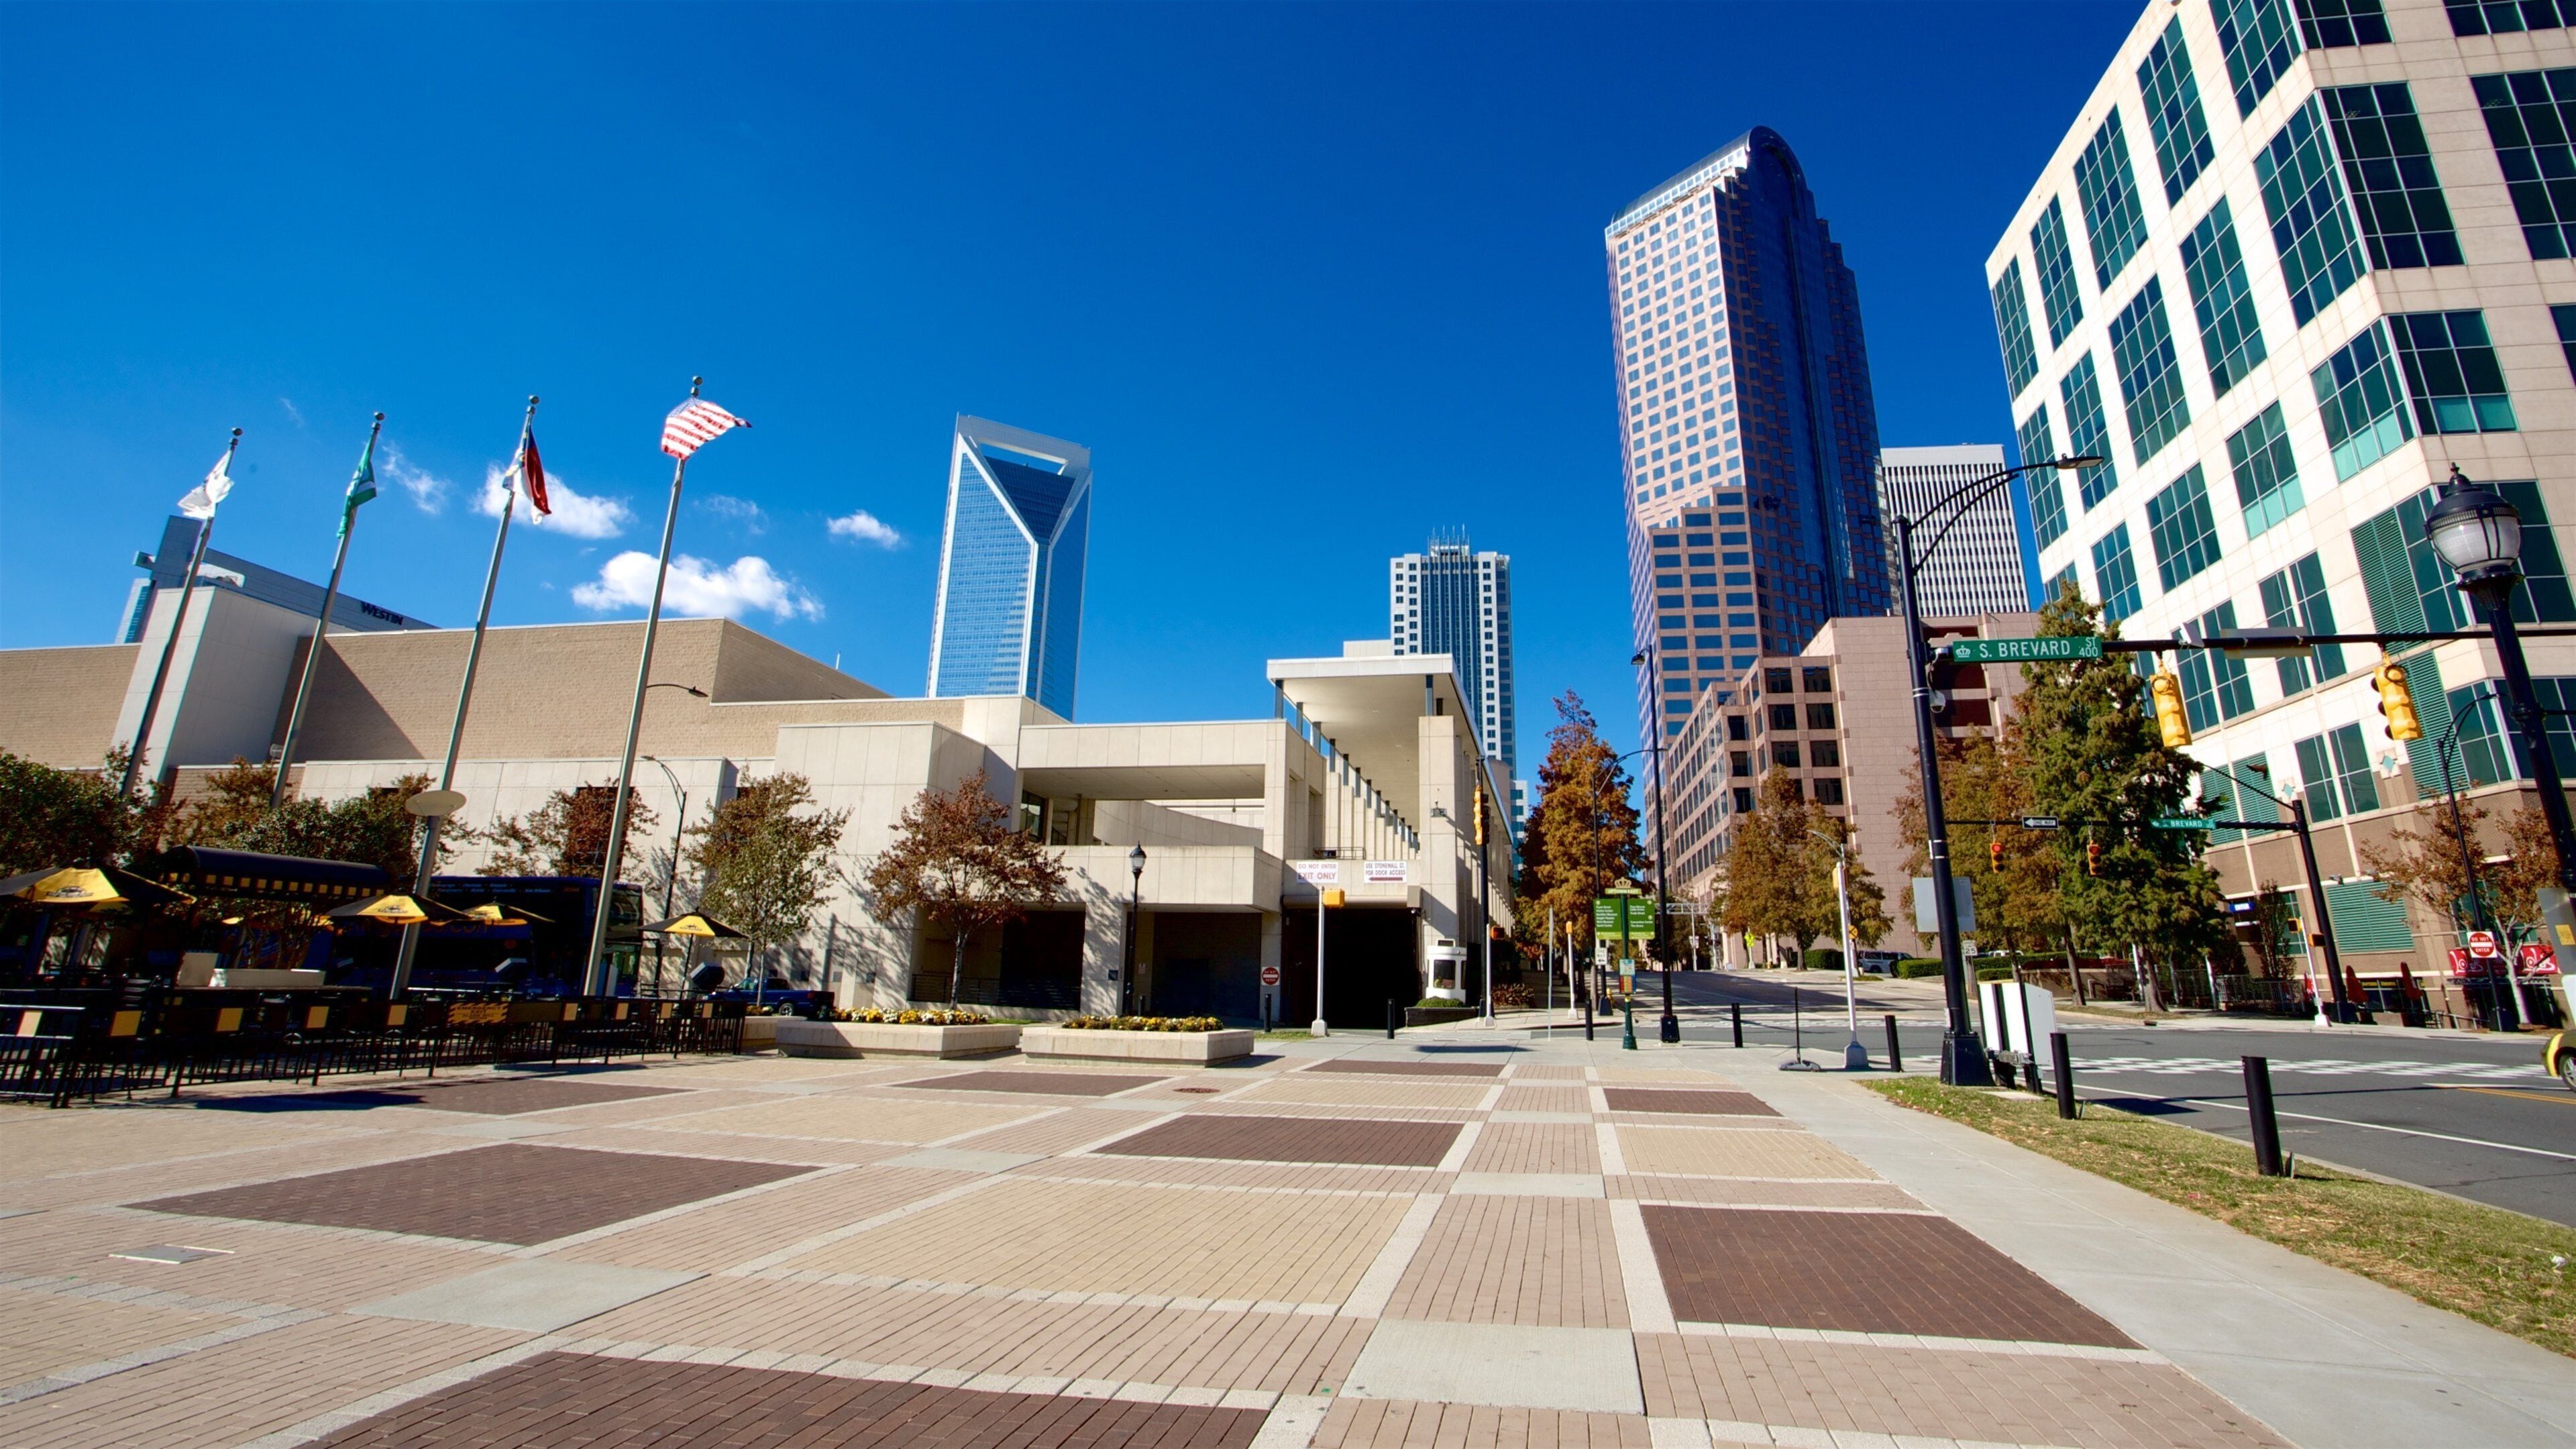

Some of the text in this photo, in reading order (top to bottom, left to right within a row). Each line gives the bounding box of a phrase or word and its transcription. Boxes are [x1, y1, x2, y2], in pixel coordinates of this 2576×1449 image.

[361, 600, 404, 625] WESTIN
[2086, 637, 2096, 647] ST
[1980, 641, 2070, 658] S. BREVARD
[2079, 647, 2098, 657] 400
[1298, 872, 1336, 880] EXIT ONLY
